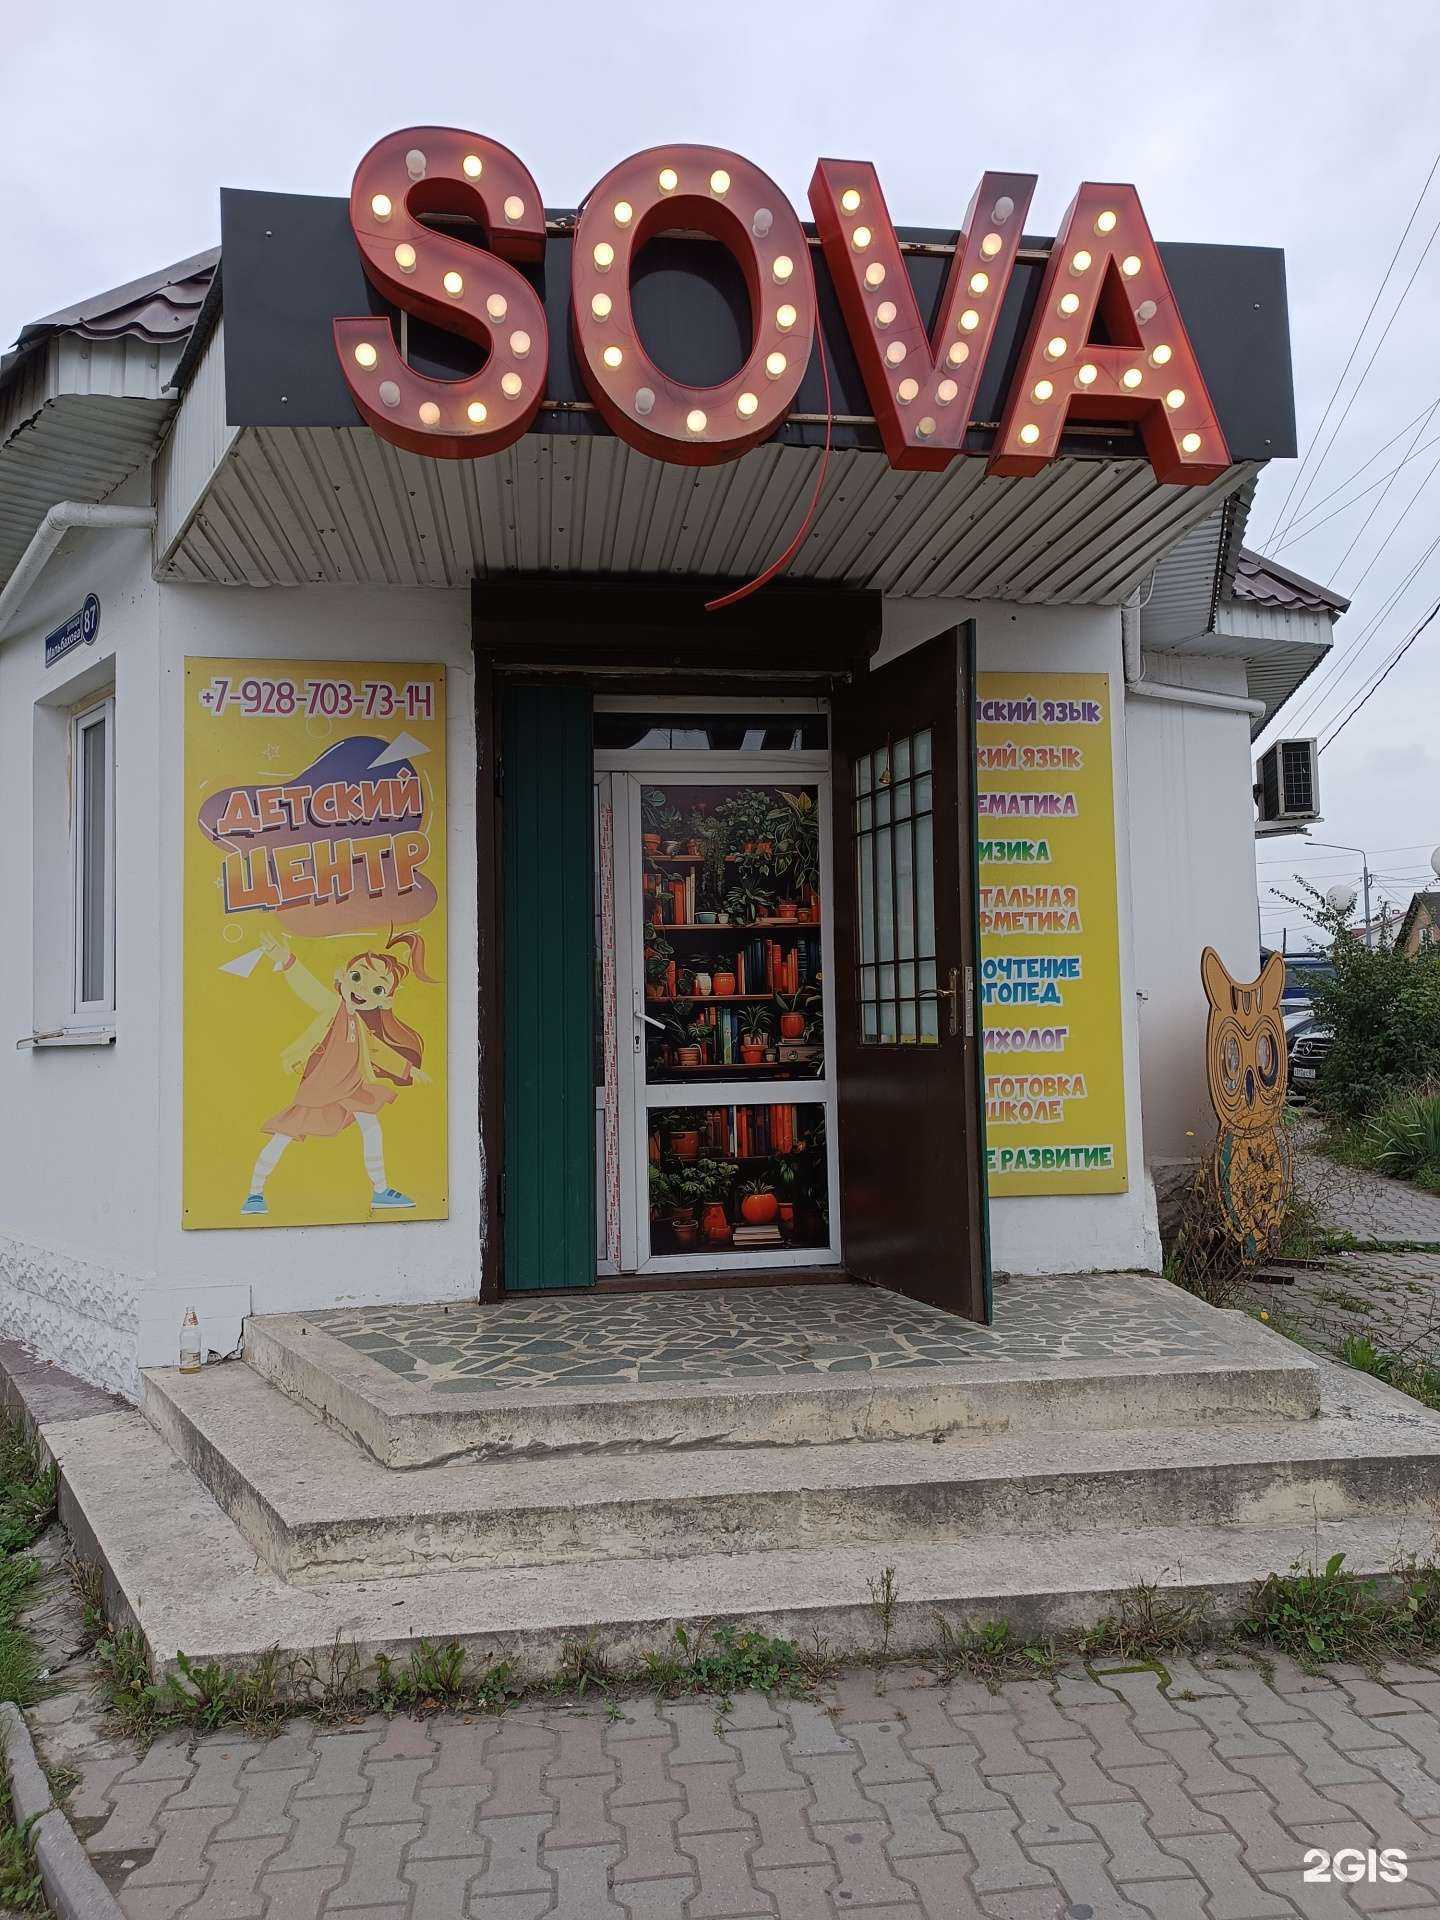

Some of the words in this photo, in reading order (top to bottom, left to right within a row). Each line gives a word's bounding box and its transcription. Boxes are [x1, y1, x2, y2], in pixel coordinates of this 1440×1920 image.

[333, 126, 1232, 486] SOVA
[84, 604, 97, 633] 87
[201, 679, 432, 718] +7-928-703-73-14
[1042, 701, 1101, 722] ЯЗЫК
[1022, 747, 1081, 769] ЯЗЫК
[217, 767, 423, 836] ДЕТСКИЙ
[225, 831, 431, 912] ЦЕНТР
[986, 1076, 1086, 1097] ГОТОВКА
[1001, 1147, 1112, 1170] РАЗВИТИЕ
